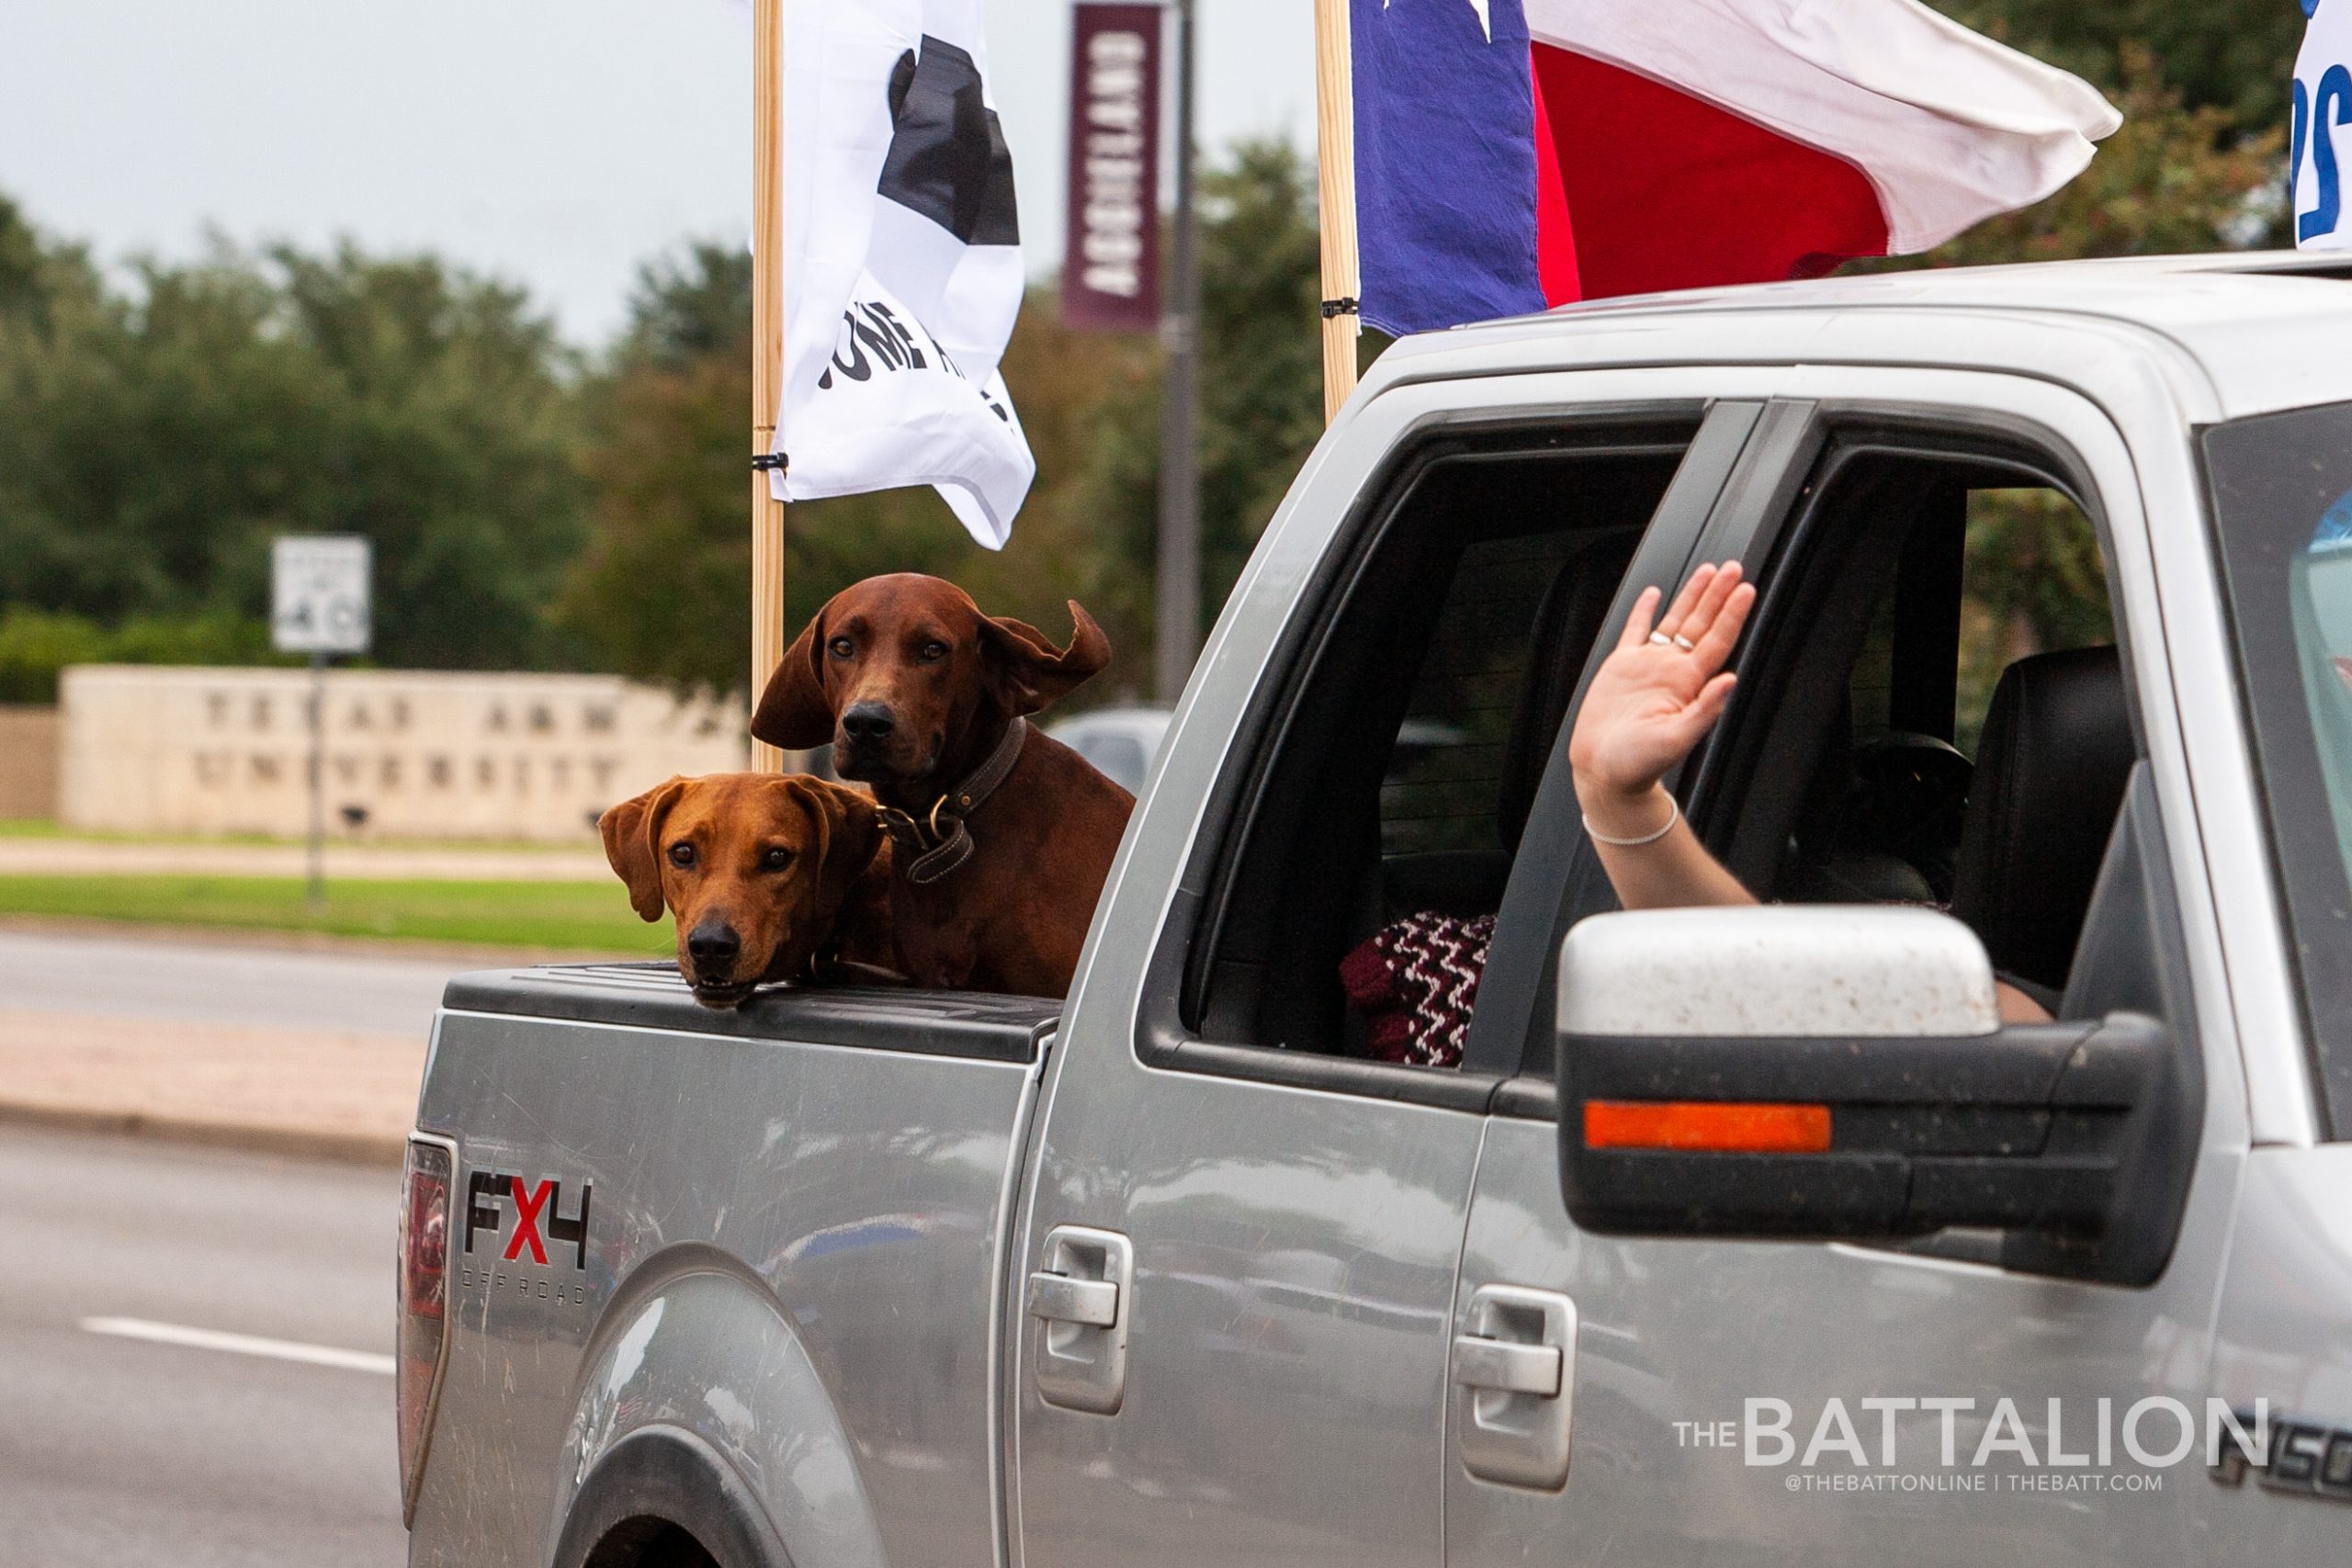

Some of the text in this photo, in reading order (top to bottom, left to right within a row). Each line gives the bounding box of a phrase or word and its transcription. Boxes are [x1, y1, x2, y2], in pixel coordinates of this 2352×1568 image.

[463, 1166, 594, 1270] FX4
[461, 1269, 586, 1304] OFF ROAD
